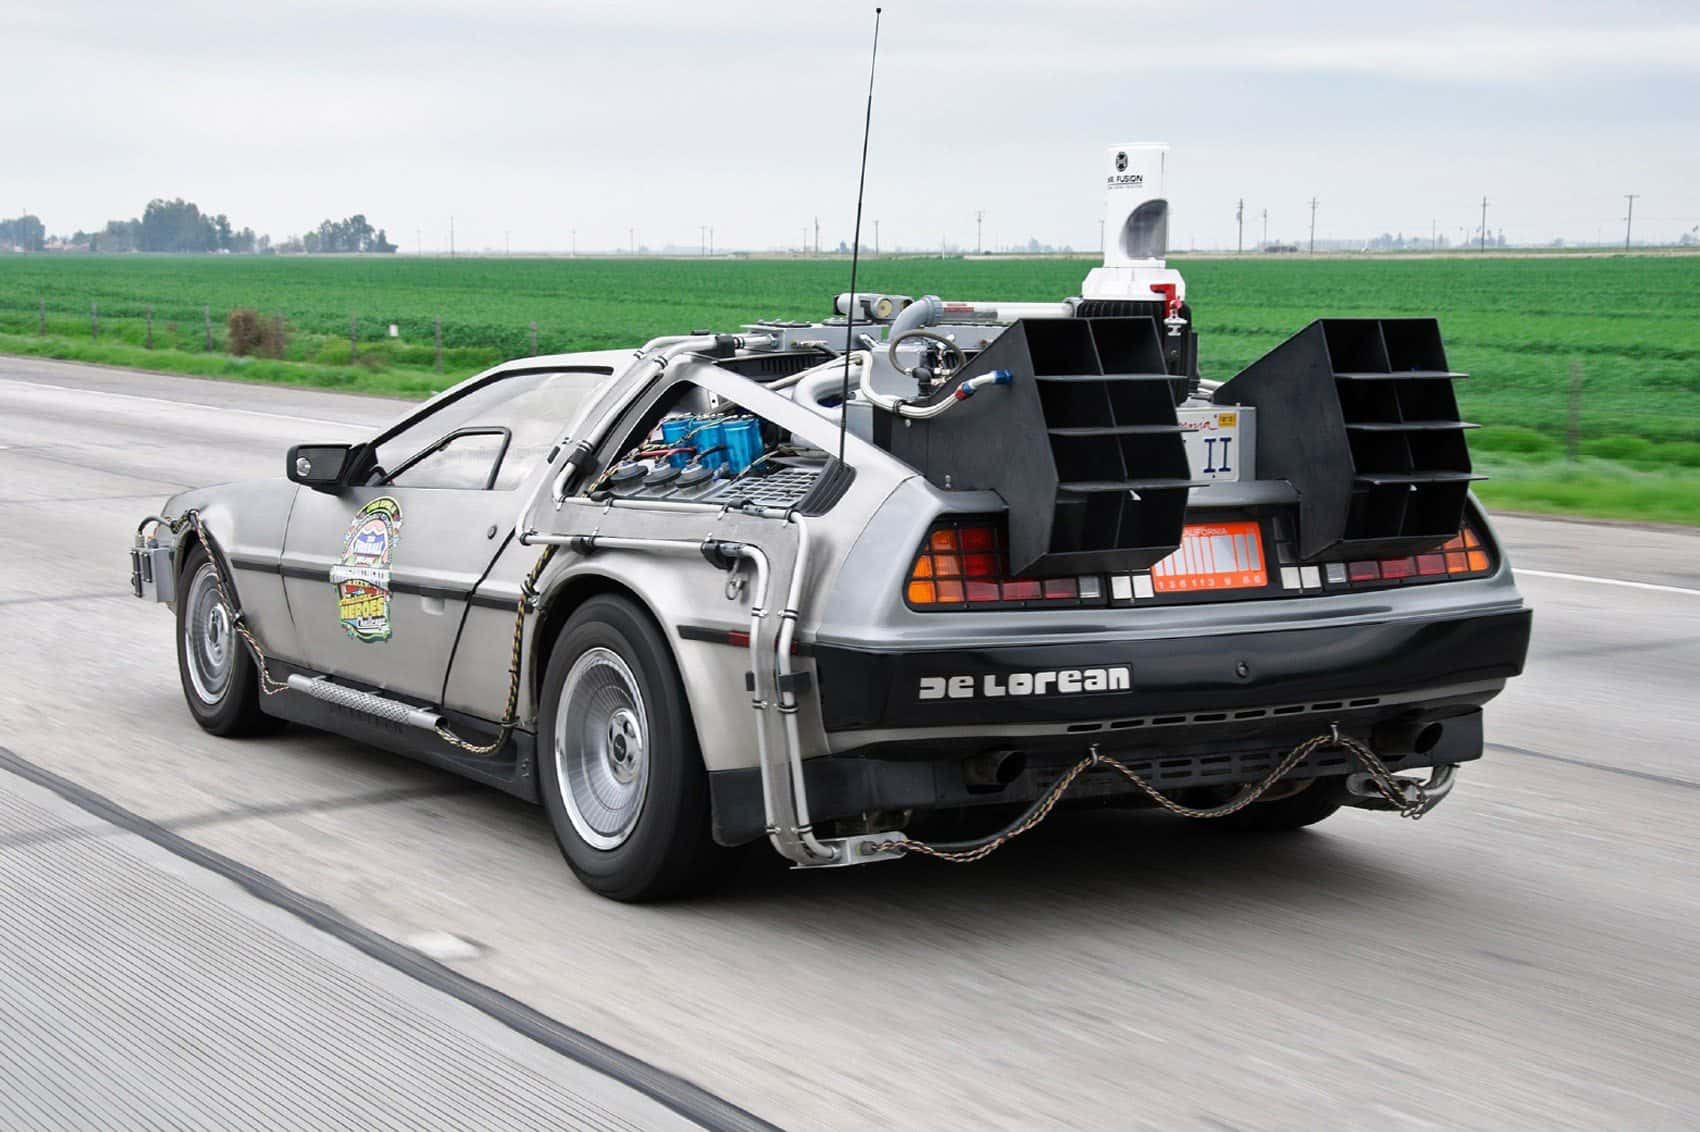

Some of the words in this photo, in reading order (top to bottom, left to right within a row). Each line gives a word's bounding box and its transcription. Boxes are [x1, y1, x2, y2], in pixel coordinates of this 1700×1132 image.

[1116, 174, 1143, 183] FUSION
[1203, 437, 1232, 473] II
[1182, 528, 1227, 537] ALIFORNIA
